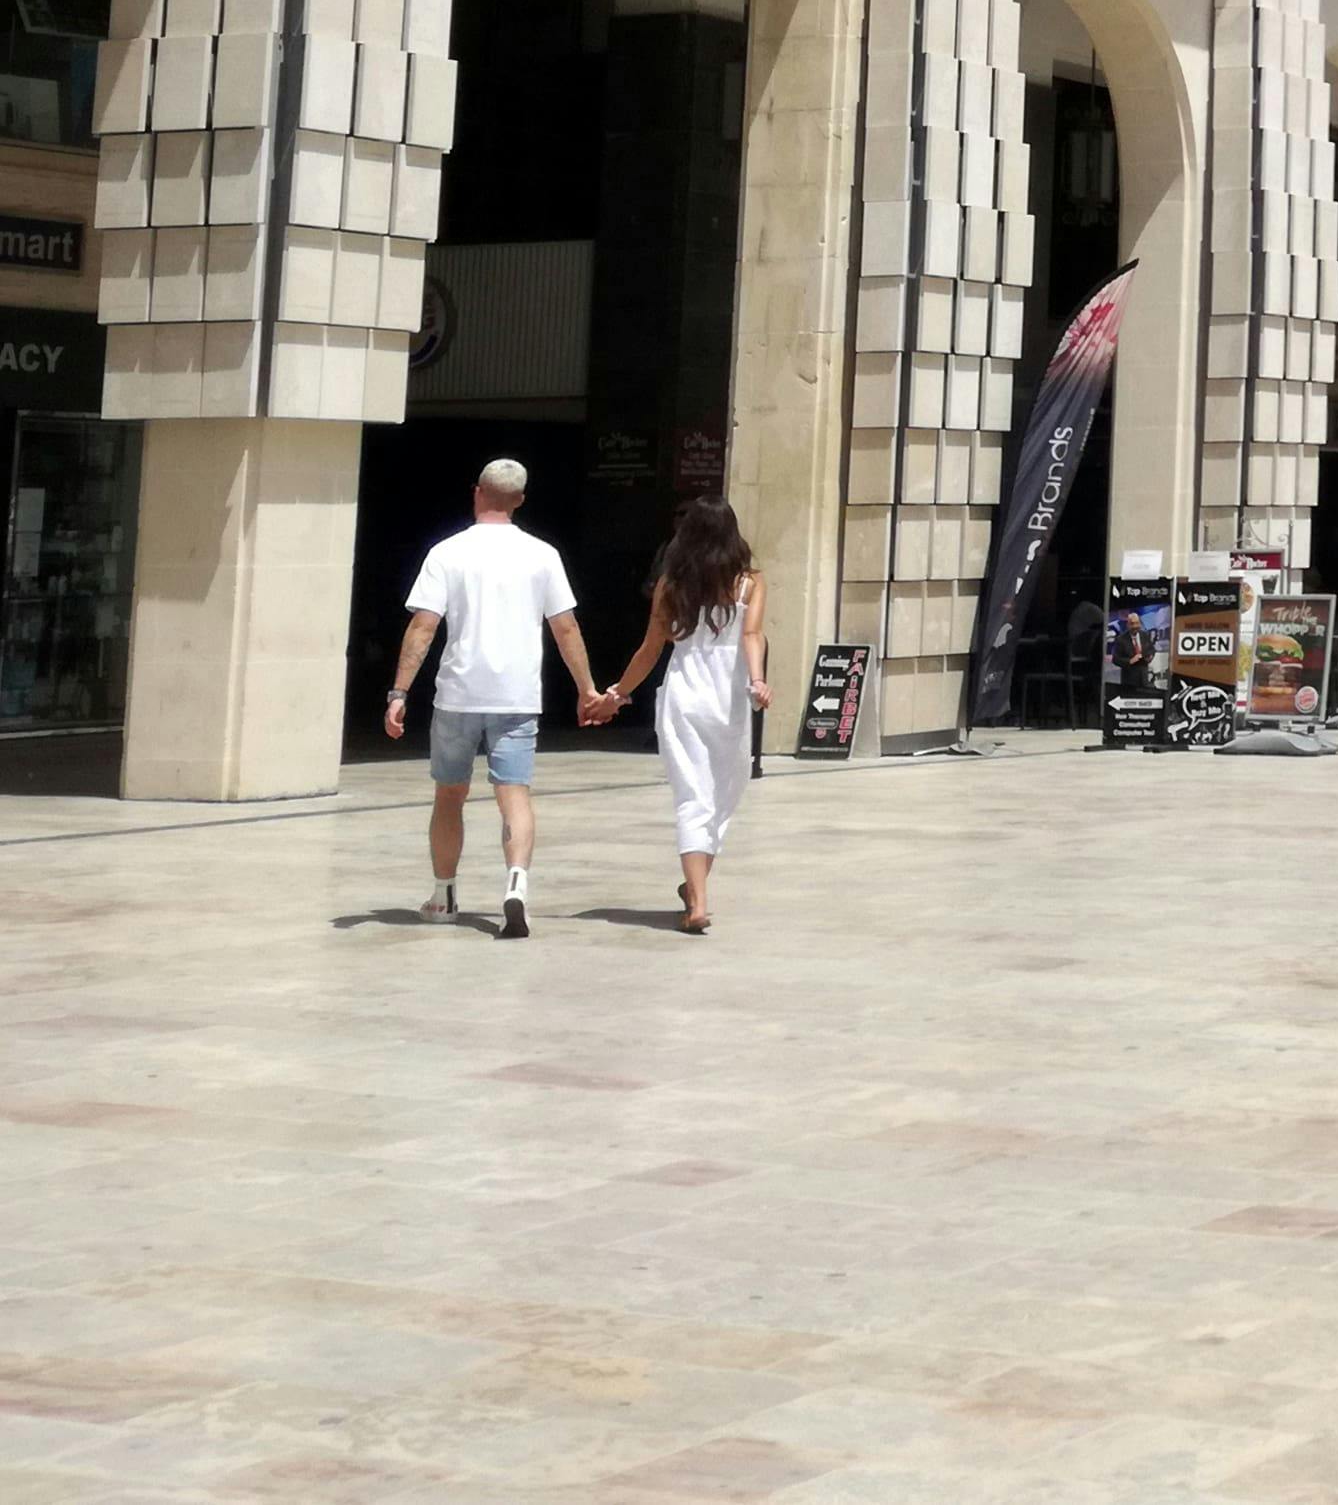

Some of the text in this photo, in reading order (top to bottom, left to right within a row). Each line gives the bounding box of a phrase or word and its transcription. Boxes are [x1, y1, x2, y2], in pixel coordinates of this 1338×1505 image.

[0, 342, 65, 374] ACY
[1028, 425, 1073, 531] Brands
[1127, 586, 1141, 597] Top
[1193, 593, 1208, 603] Top
[1181, 636, 1230, 652] OPEN
[818, 655, 850, 671] Gaming
